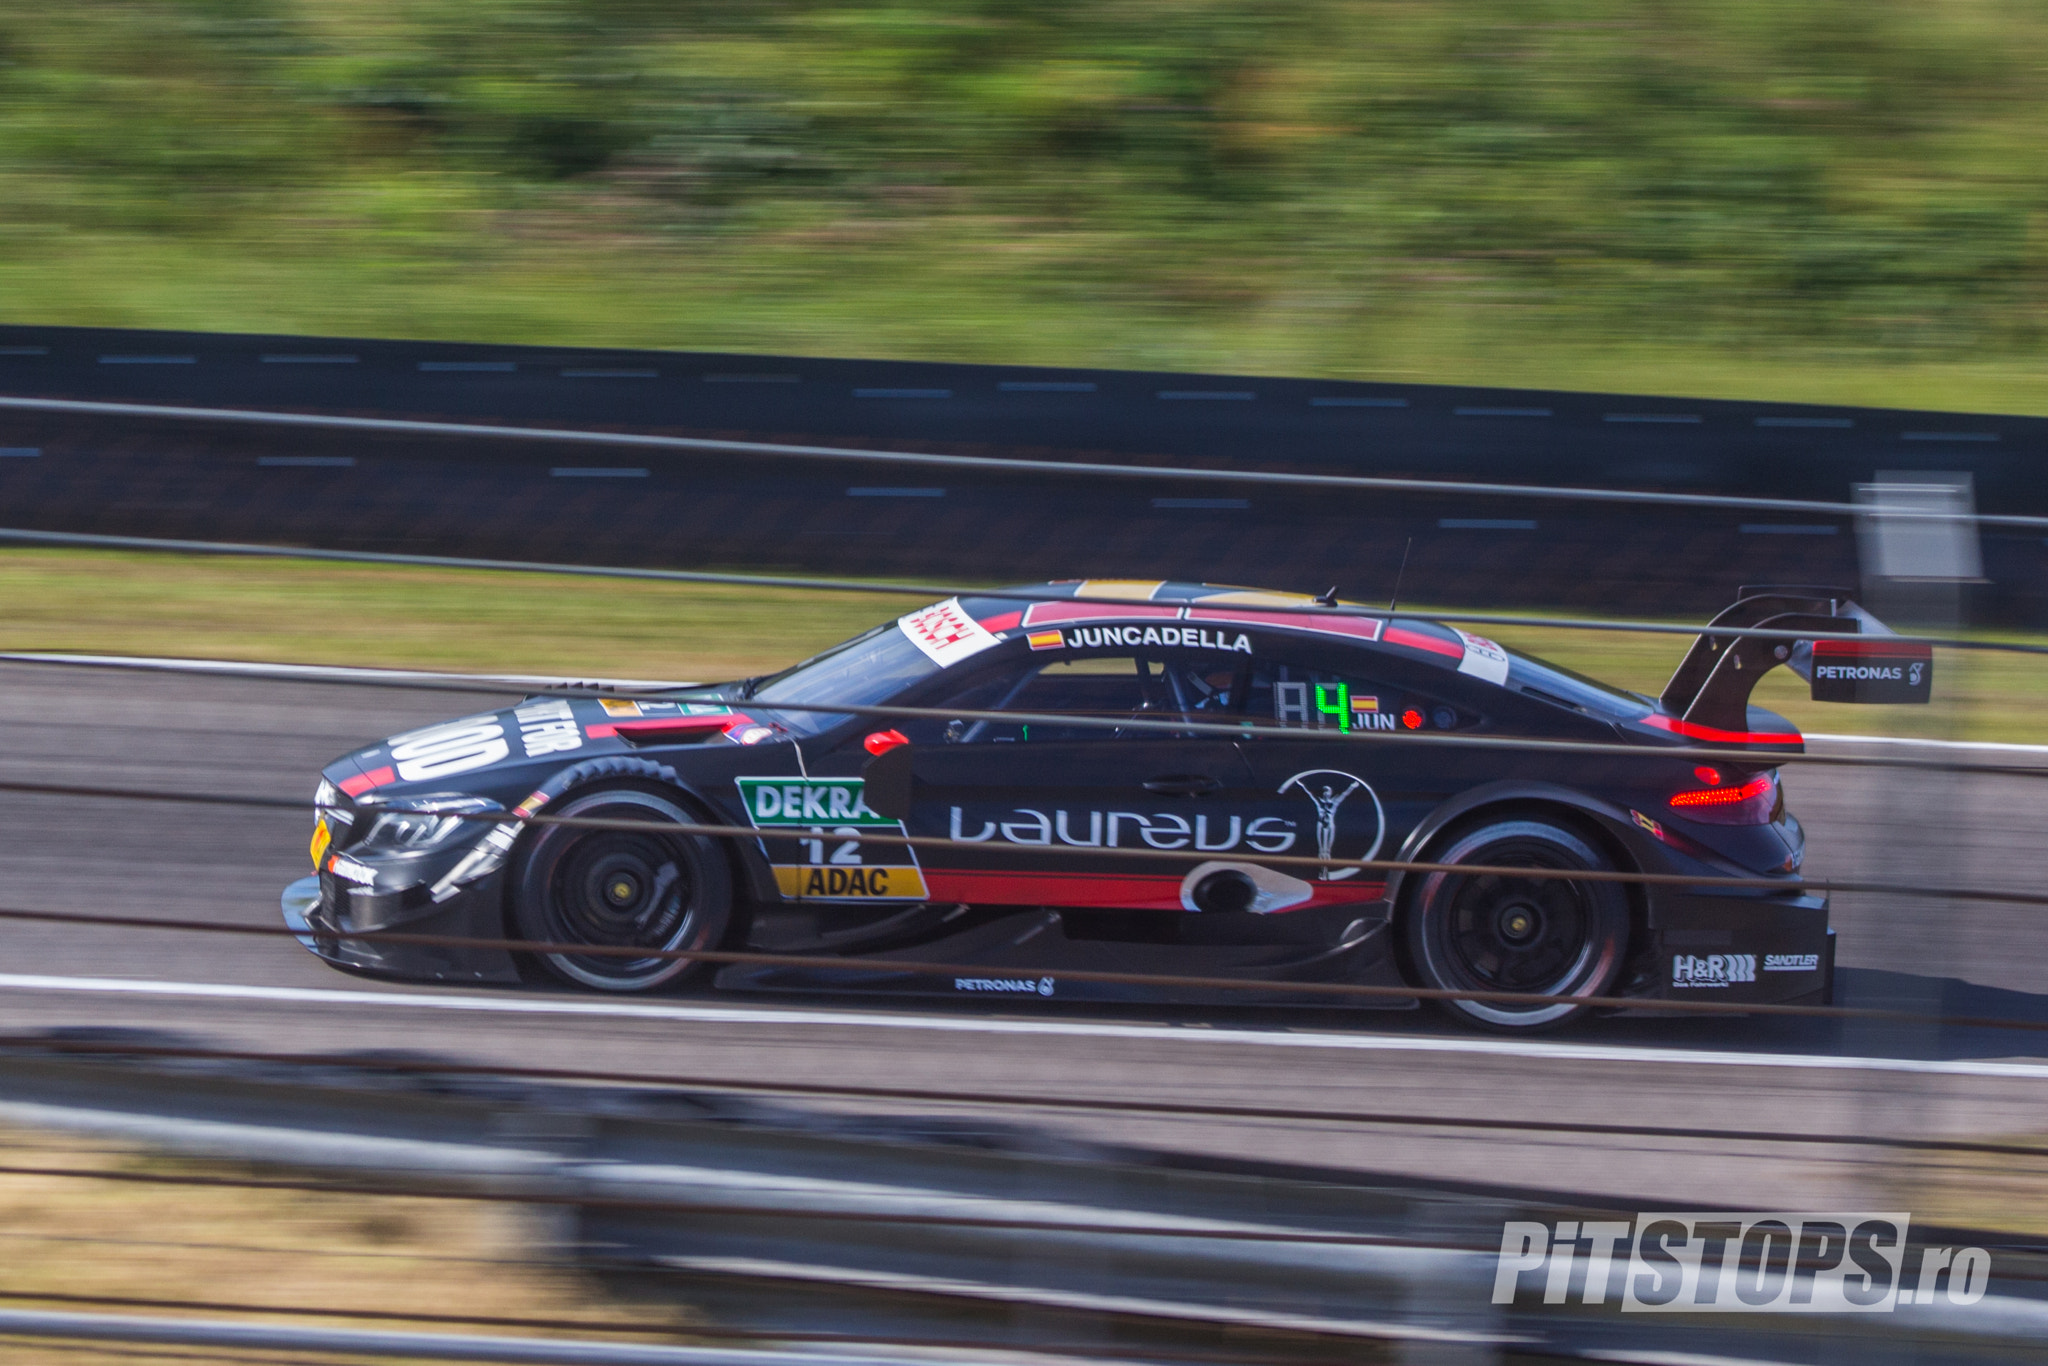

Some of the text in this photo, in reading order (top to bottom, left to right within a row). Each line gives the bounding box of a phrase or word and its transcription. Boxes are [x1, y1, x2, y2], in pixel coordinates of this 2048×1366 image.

[1068, 627, 1252, 655] JUNCADELLA
[1816, 665, 1902, 680] PETRONAS
[1352, 713, 1396, 731] JUN
[799, 826, 862, 865] 12
[806, 867, 889, 896] ADAC
[1673, 954, 1728, 982] H&R
[954, 978, 1037, 992] PETRONAS
